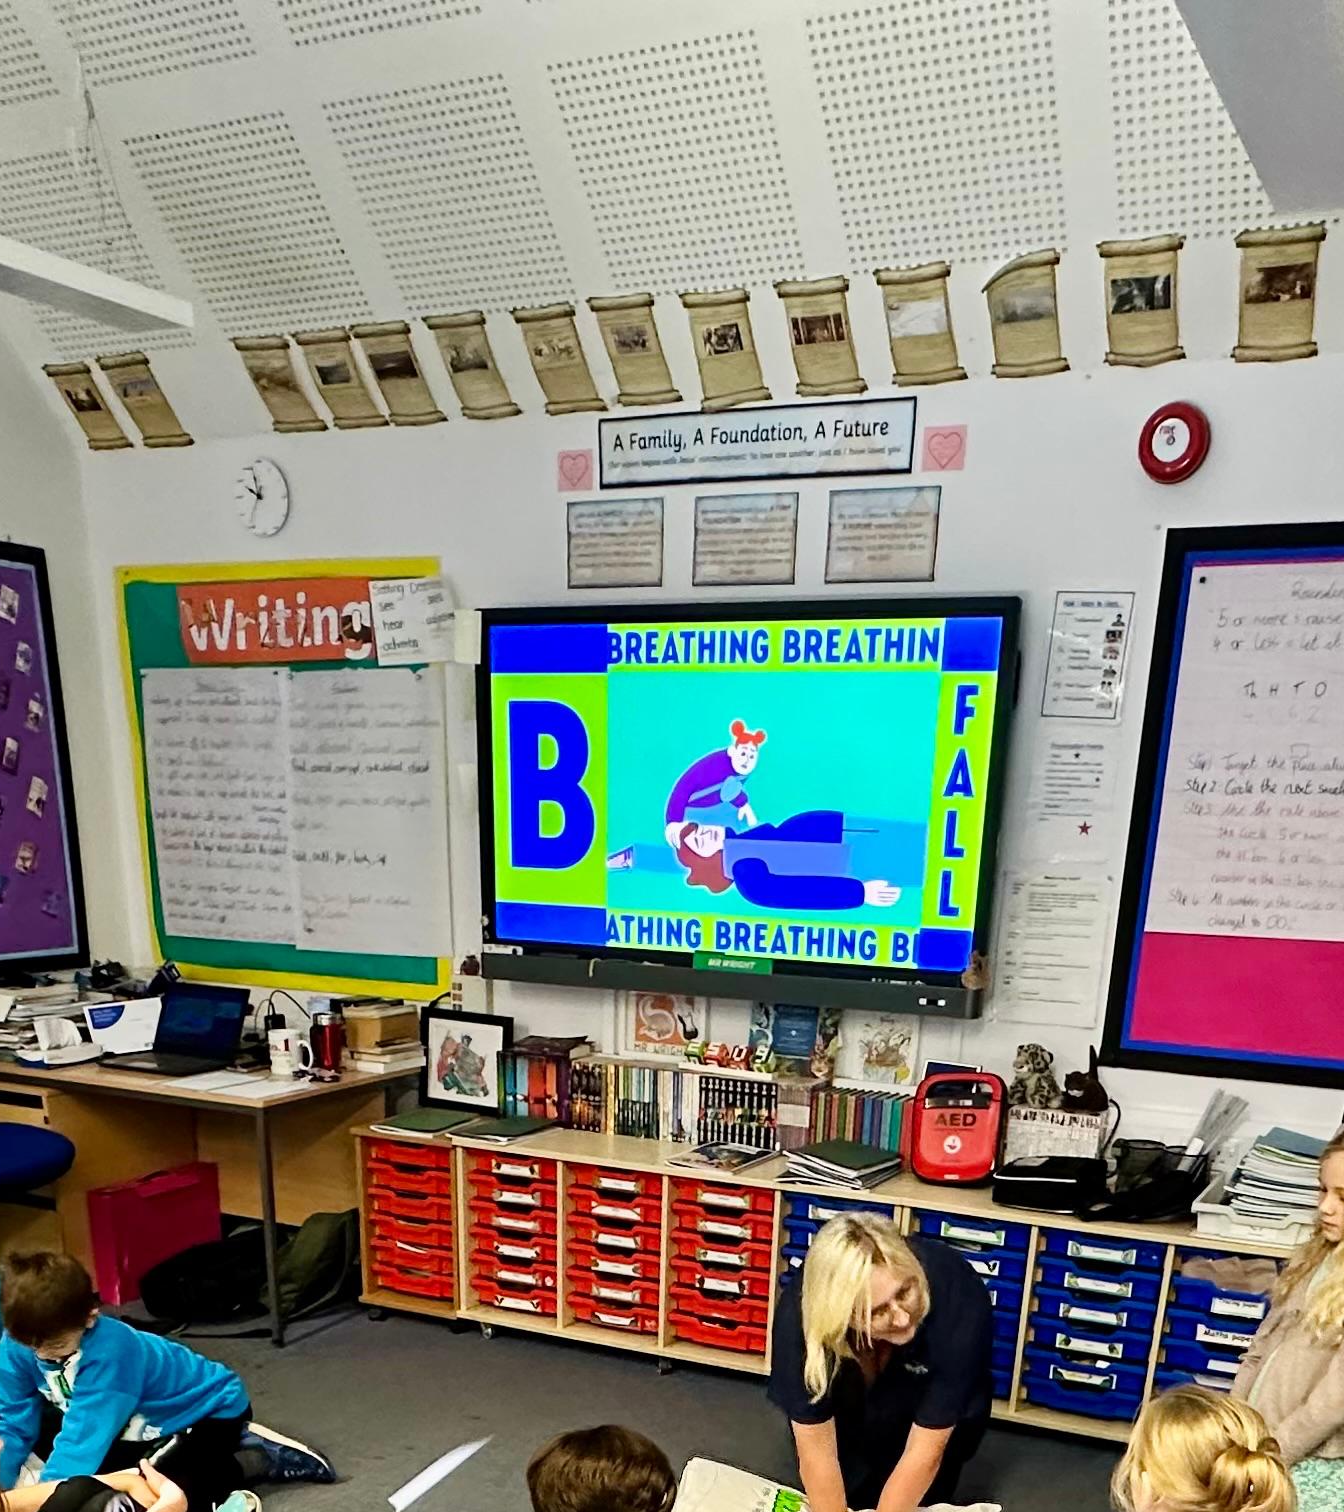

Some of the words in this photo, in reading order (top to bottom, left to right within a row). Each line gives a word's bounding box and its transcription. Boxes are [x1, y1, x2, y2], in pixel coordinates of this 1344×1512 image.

[613, 434, 624, 451] A
[630, 429, 687, 453] Family,
[693, 427, 704, 446] A
[711, 422, 807, 445] Foundation,
[815, 420, 826, 439] A
[833, 420, 889, 438] Future
[181, 591, 373, 660] Writing
[607, 628, 769, 665] BREATHING
[1269, 684, 1280, 696] H
[509, 700, 595, 869] B
[938, 685, 979, 917] FALL
[1260, 778, 1277, 795] the
[715, 920, 877, 961] BREATHING
[708, 957, 723, 970] MR
[724, 959, 755, 970] WRIGHT
[935, 1112, 977, 1127] AED
